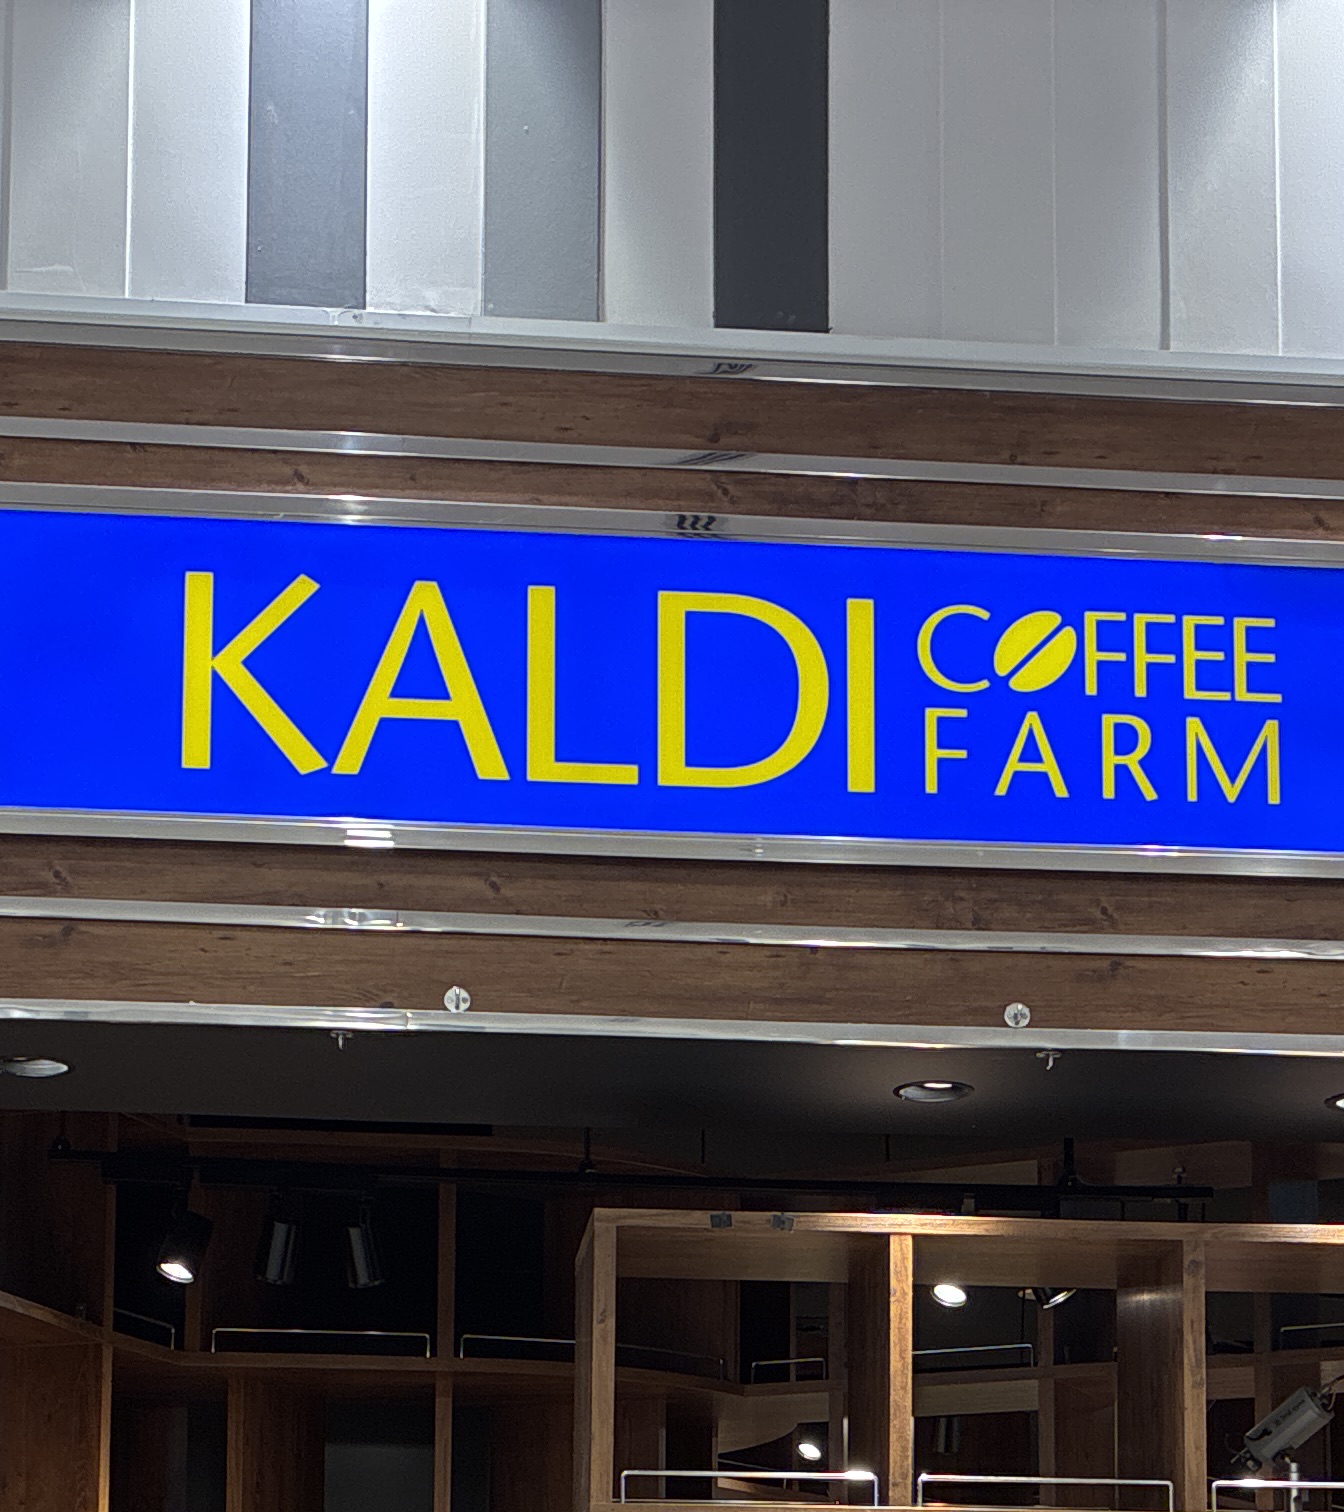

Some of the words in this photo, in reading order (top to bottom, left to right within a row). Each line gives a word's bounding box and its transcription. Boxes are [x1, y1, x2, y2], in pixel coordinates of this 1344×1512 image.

[181, 571, 878, 794] KALDI
[917, 603, 1277, 704] COFFEE
[923, 706, 1281, 805] FARM
